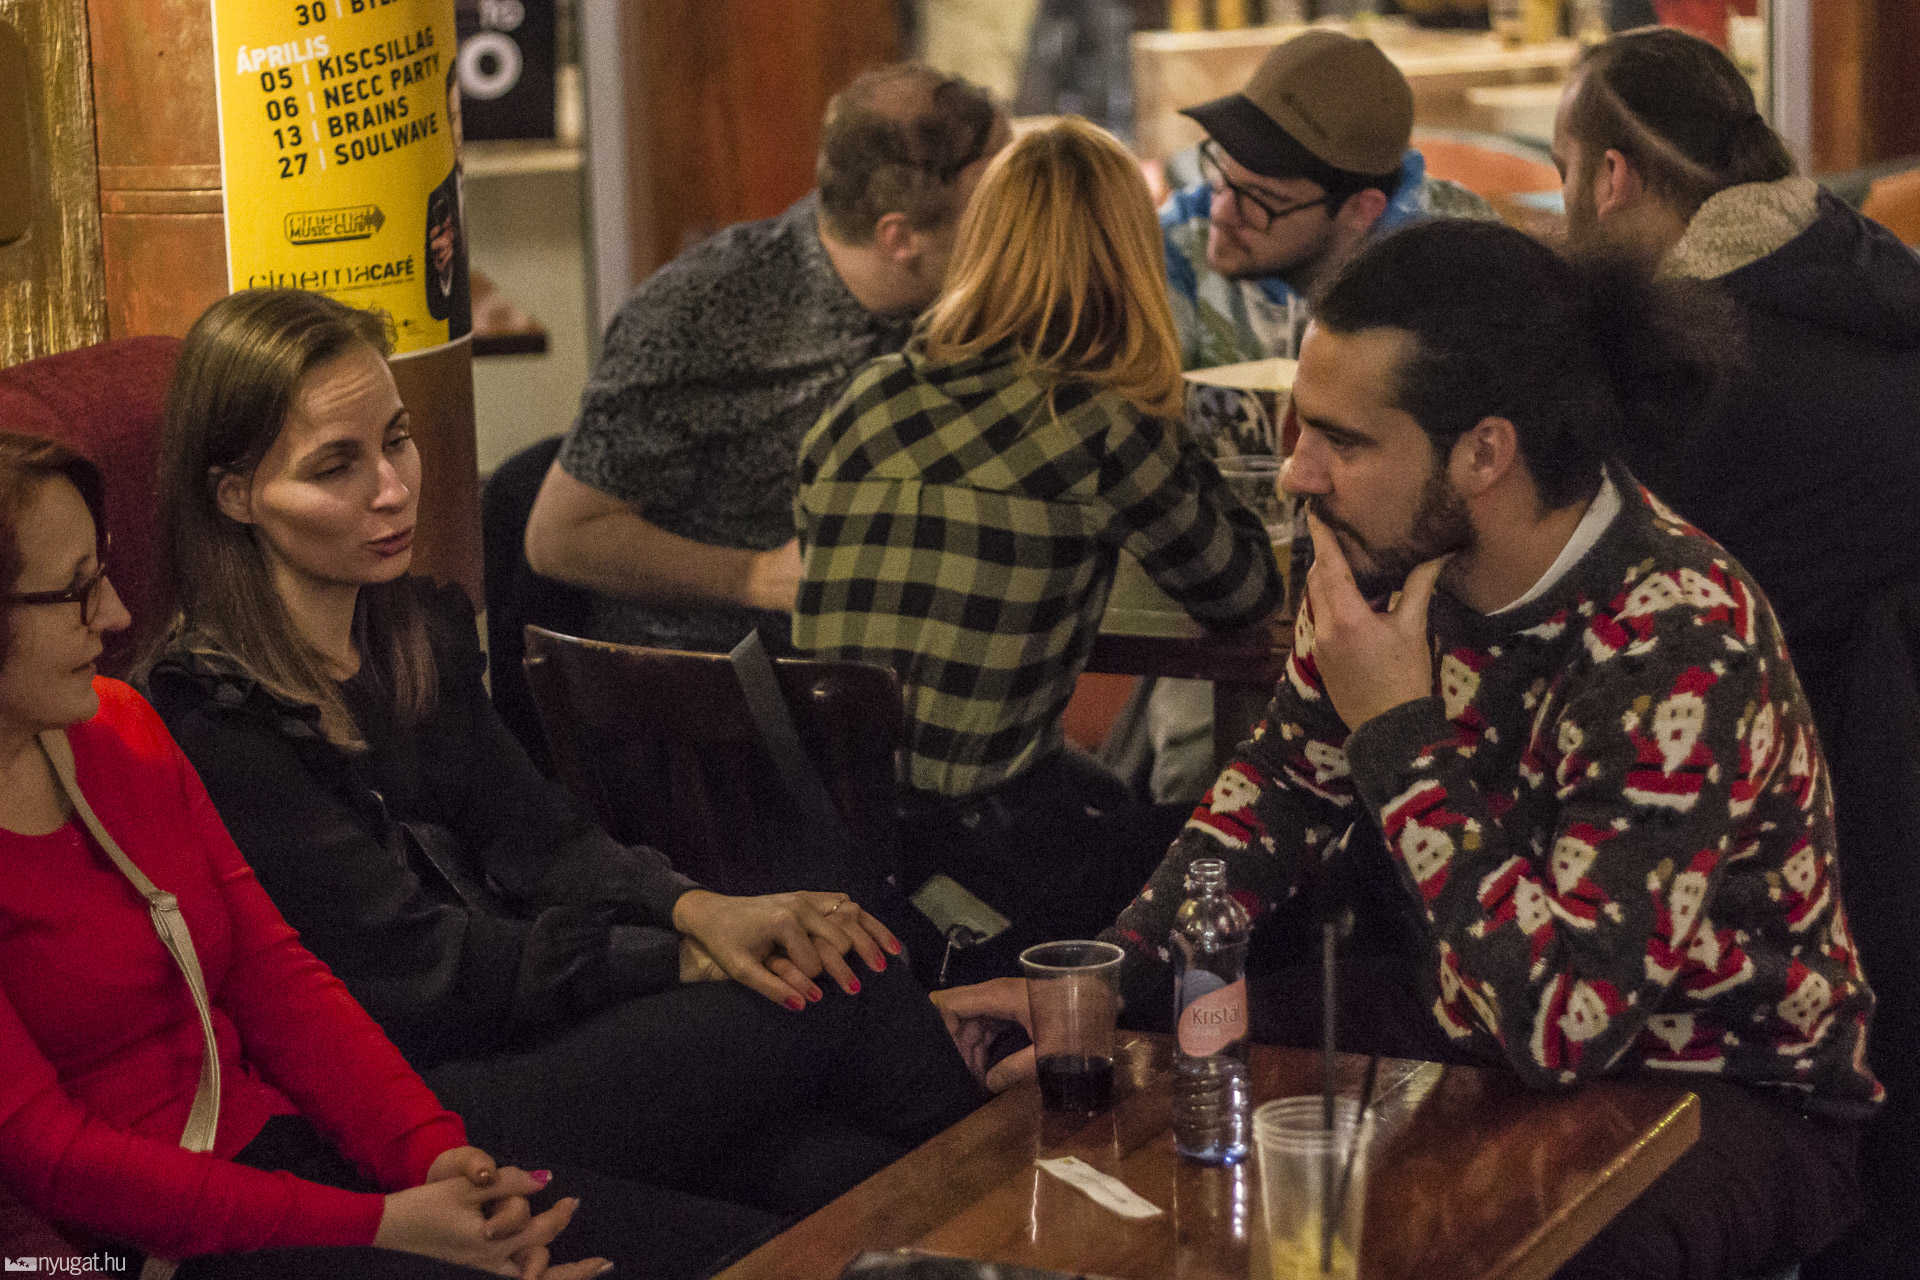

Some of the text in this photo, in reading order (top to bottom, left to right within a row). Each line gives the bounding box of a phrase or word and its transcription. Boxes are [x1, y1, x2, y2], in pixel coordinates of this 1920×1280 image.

[296, 1, 326, 26] 30
[236, 35, 330, 75] ÁPRILIS
[260, 67, 293, 93] 05
[266, 55, 440, 122] 06 NECC PARTY
[273, 96, 410, 150] 13 BRAINS
[278, 112, 439, 179] 27 SOULWAVE
